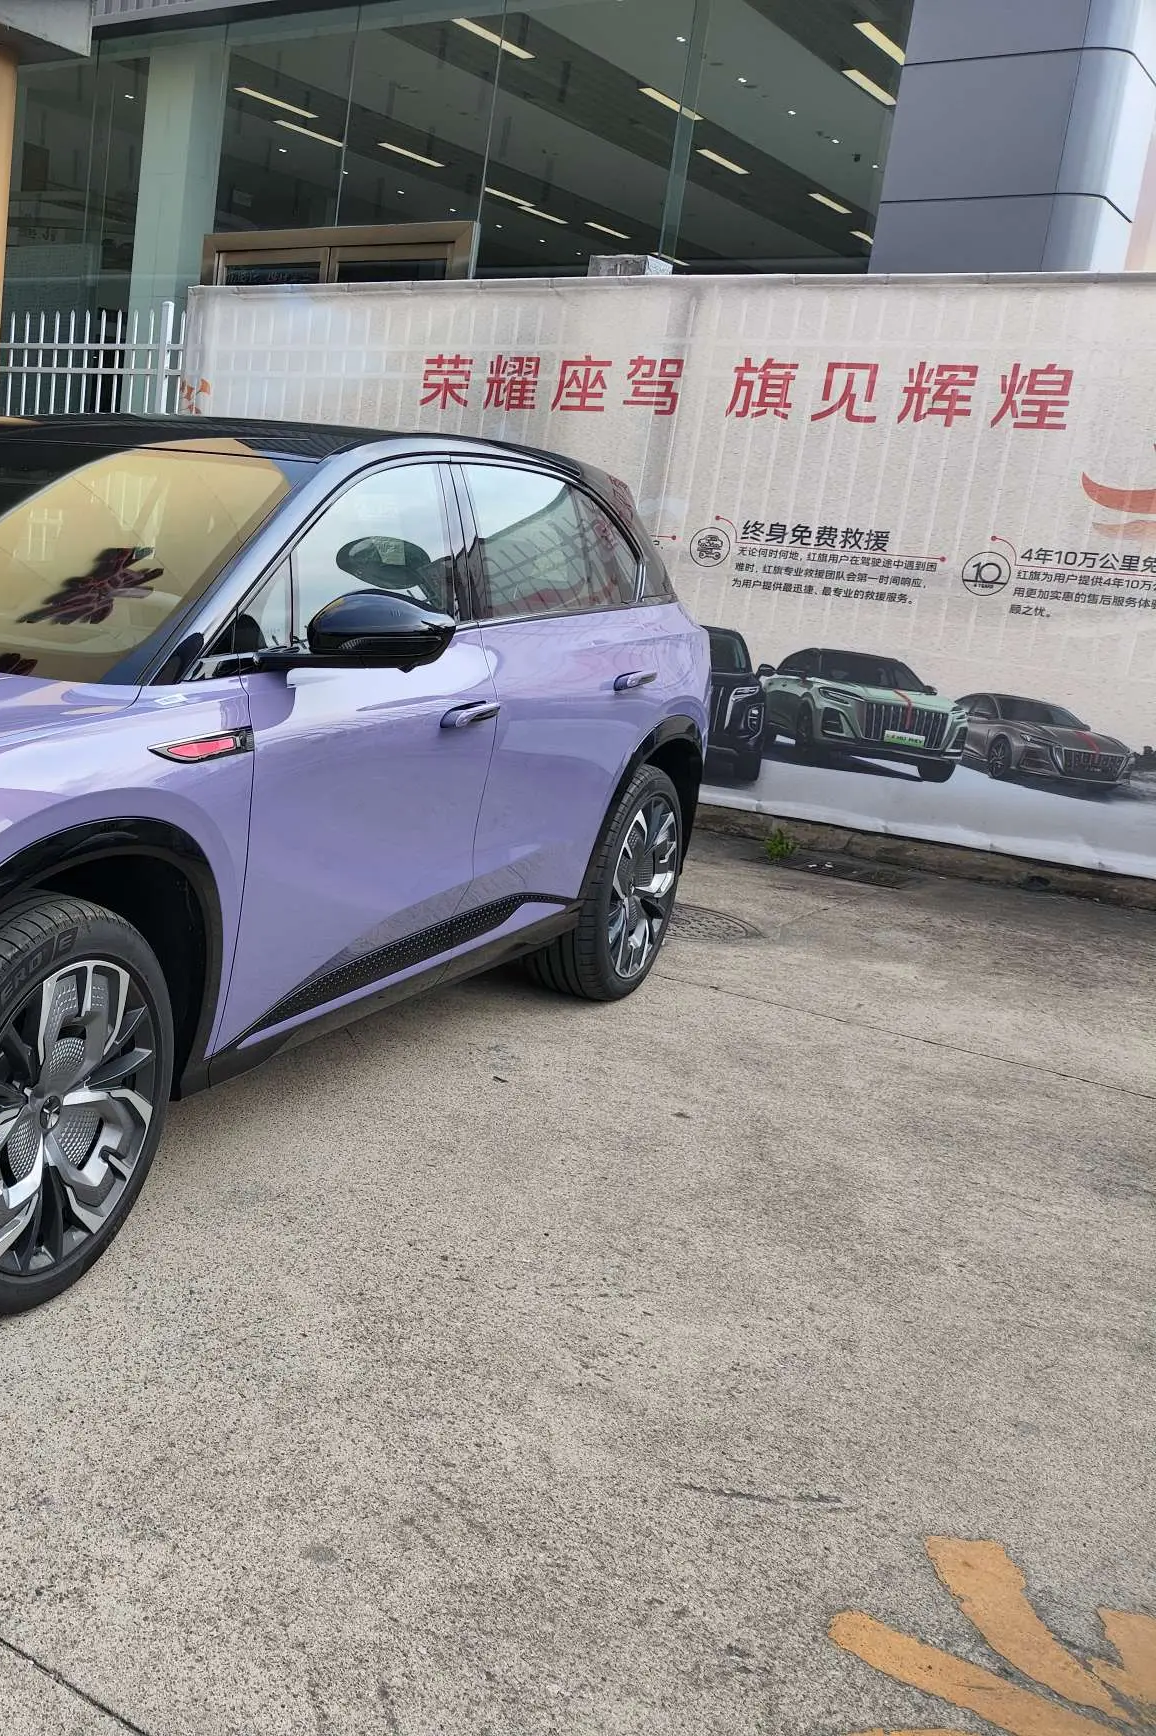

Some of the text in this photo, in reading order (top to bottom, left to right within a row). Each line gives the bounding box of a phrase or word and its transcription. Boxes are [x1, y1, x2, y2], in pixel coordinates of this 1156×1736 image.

[419, 354, 1074, 431] 荣耀座驾 旗见辉煌
[740, 520, 891, 552] 终身免费救援
[972, 562, 1002, 583] 10
[1016, 570, 1156, 591] 红旗为用户提供4年10万
